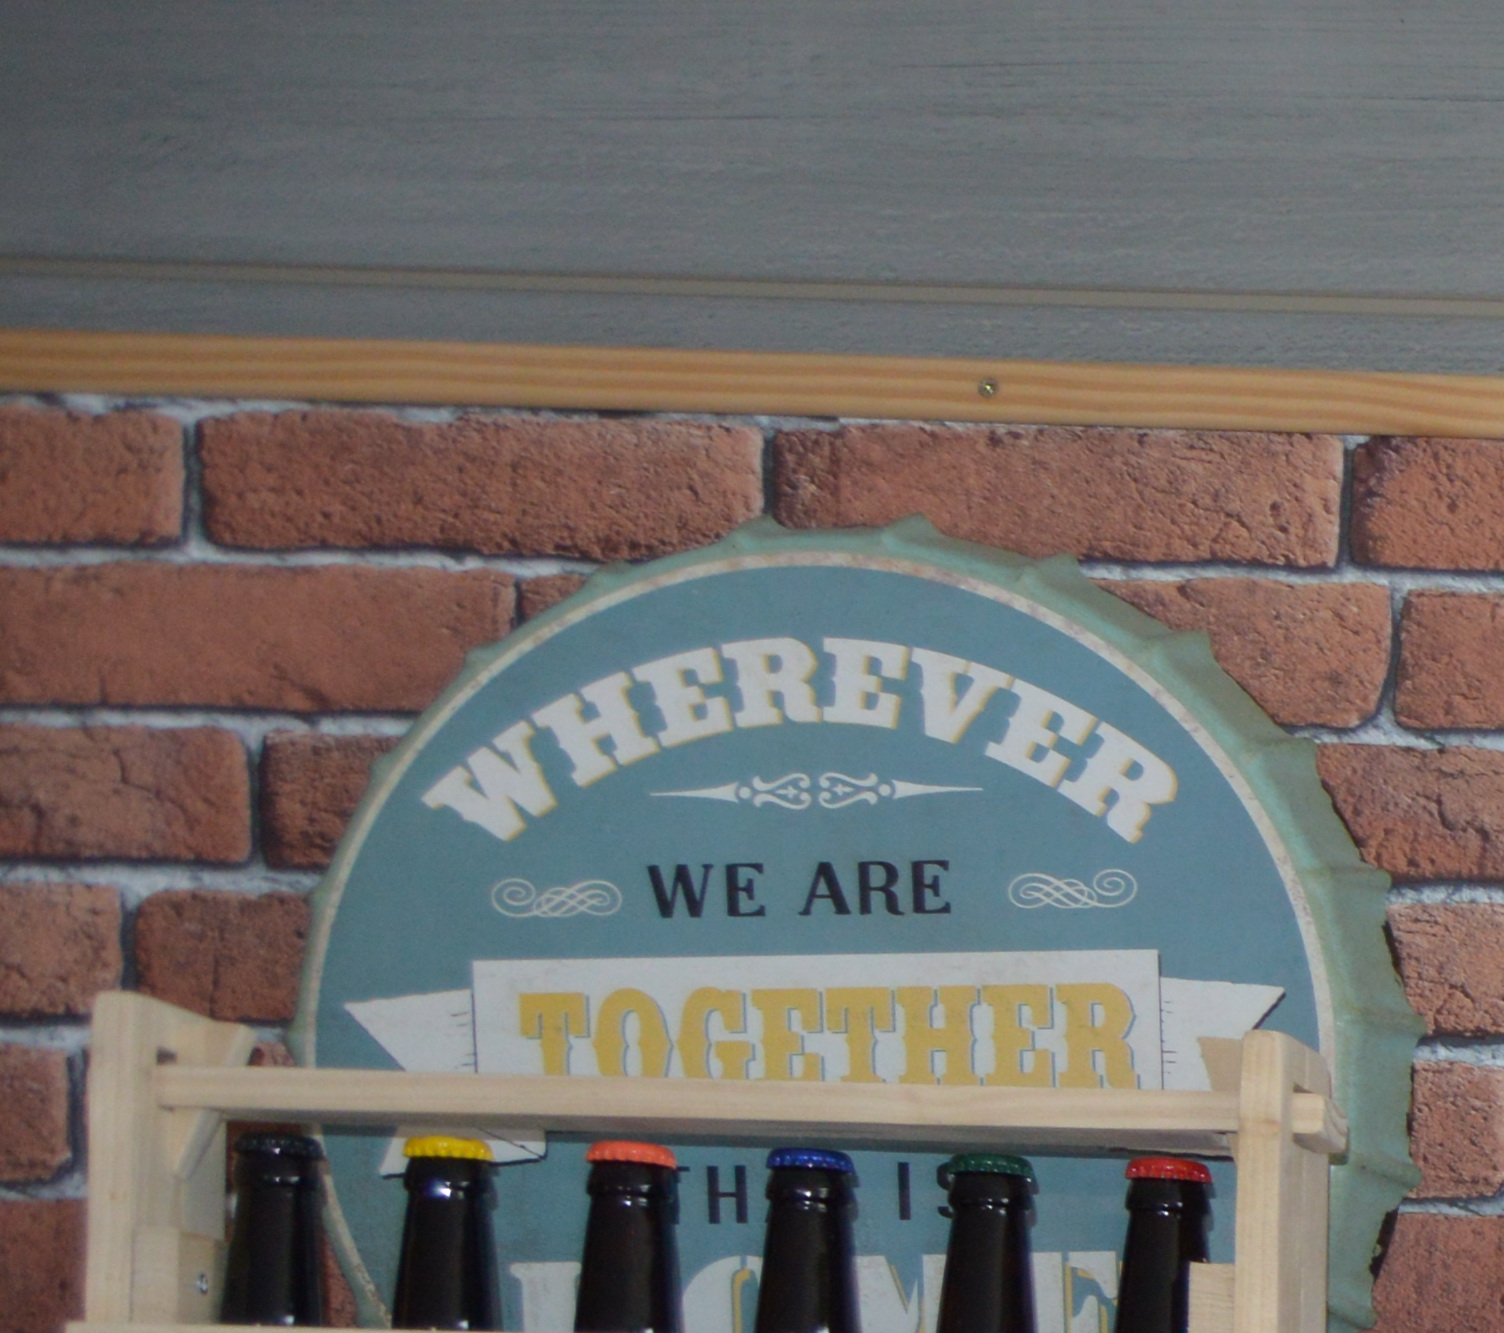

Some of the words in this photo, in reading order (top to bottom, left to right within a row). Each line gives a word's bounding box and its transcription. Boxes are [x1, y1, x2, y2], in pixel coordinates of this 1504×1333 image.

[421, 634, 1182, 846] WHEREVER
[647, 862, 768, 920] WE
[799, 858, 953, 918] ARE
[517, 981, 1144, 1090] TOGETHER
